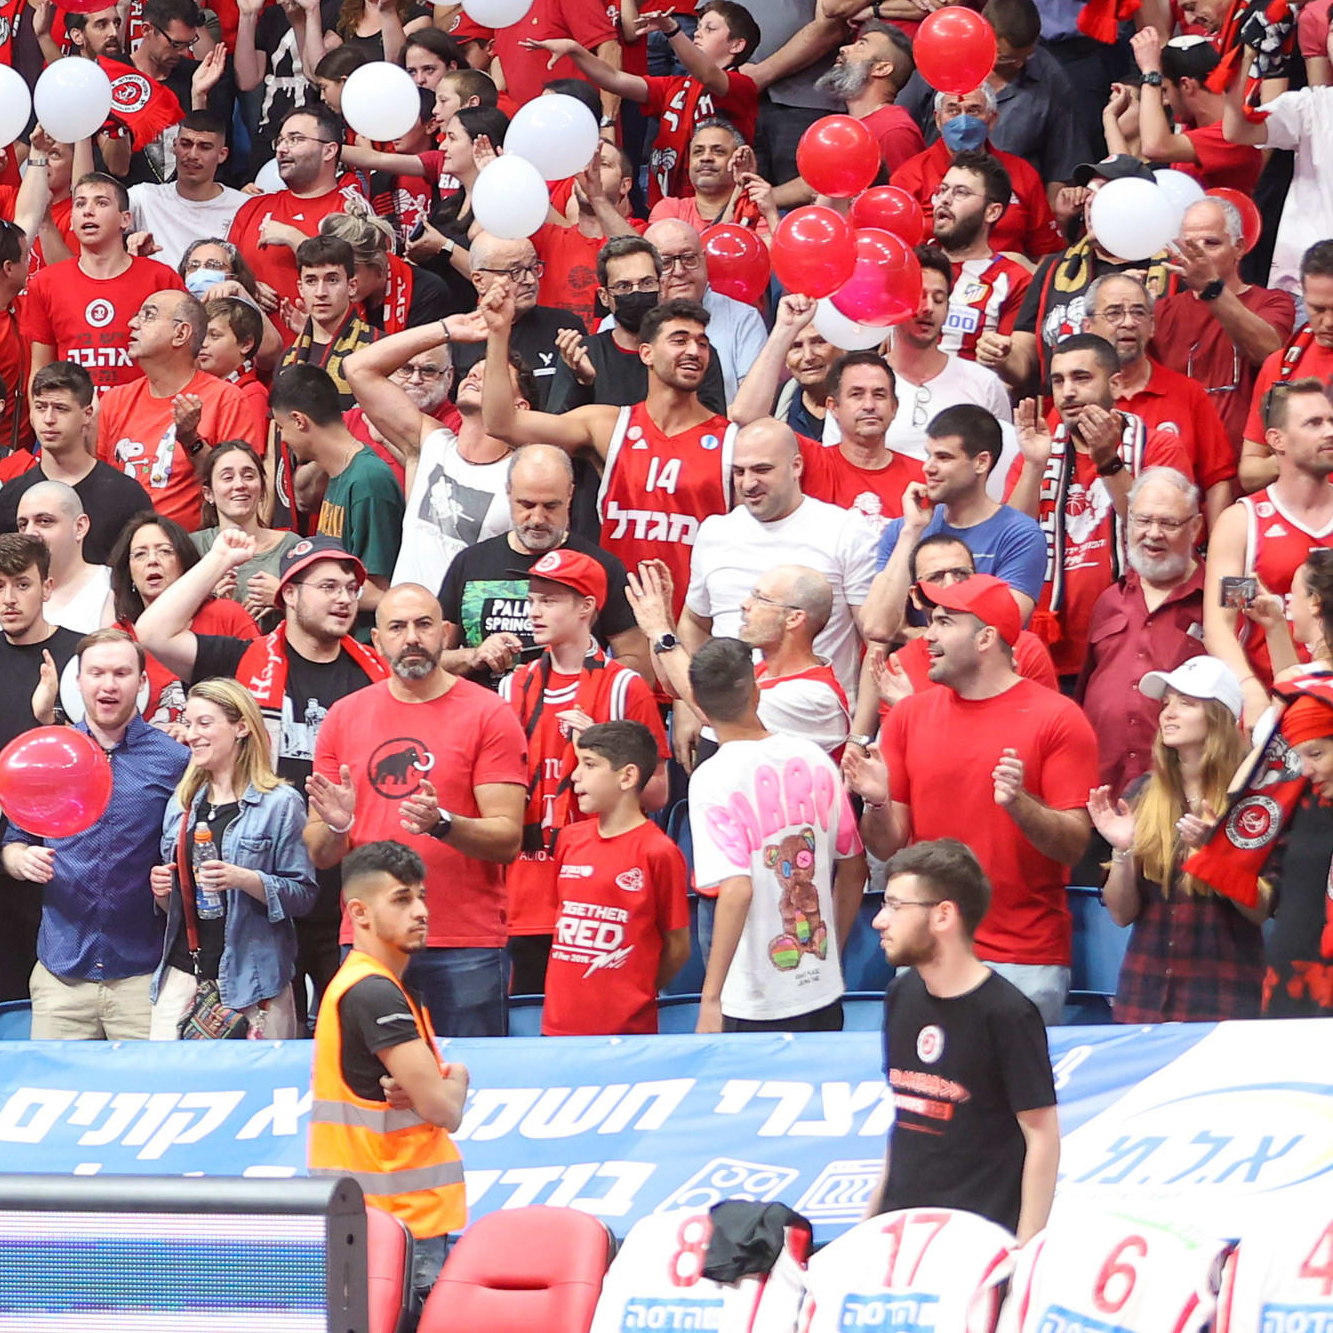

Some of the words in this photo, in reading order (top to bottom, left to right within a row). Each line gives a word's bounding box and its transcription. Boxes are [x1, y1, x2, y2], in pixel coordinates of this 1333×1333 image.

[71, 348, 134, 368] אהבה
[646, 456, 682, 496] 14
[608, 502, 699, 547] מגדל
[556, 916, 624, 942] RED
[668, 1214, 715, 1287] 8
[880, 1213, 952, 1288] 17
[1093, 1235, 1148, 1314] 6
